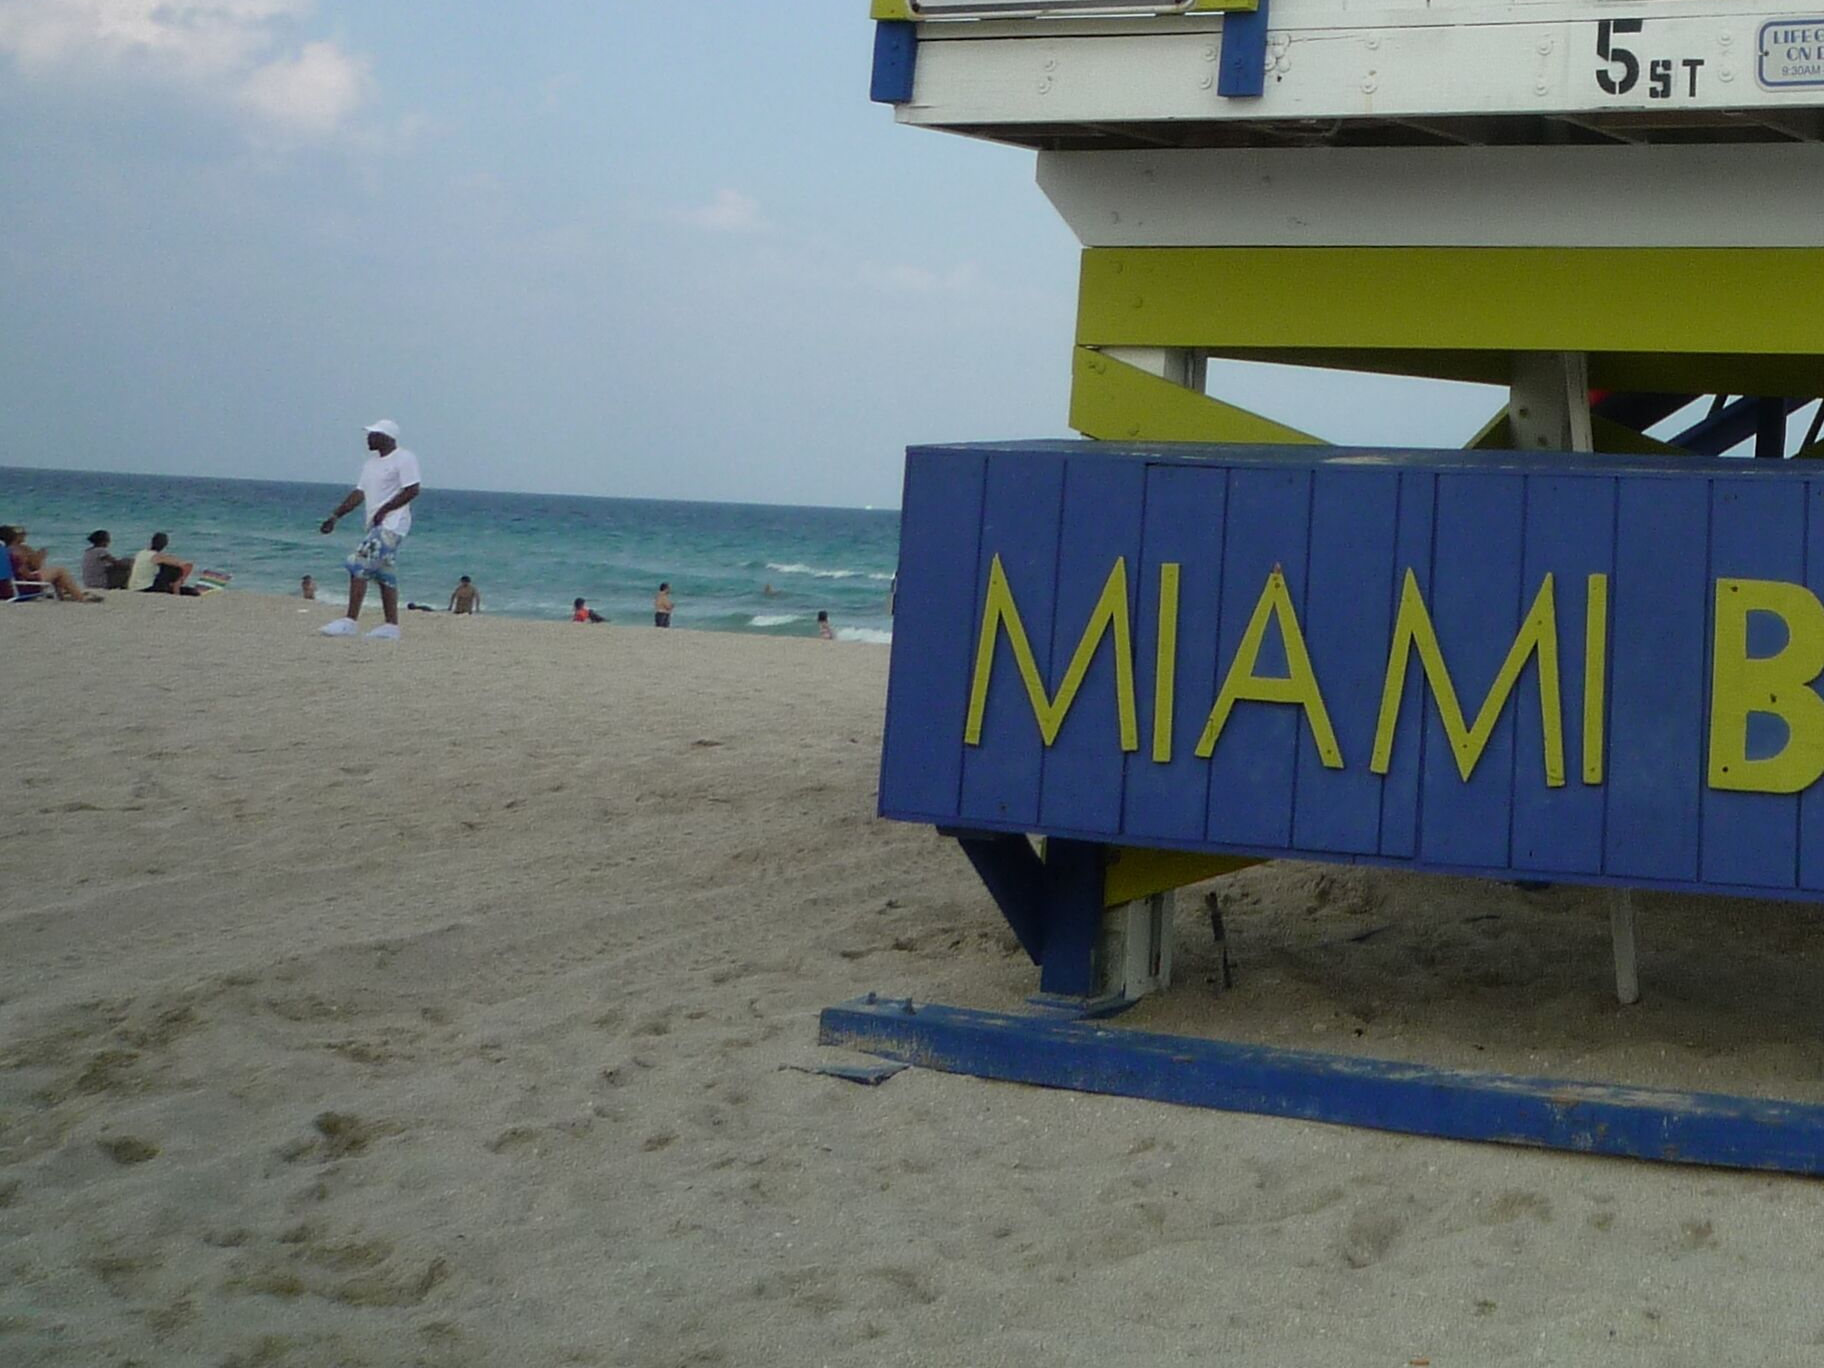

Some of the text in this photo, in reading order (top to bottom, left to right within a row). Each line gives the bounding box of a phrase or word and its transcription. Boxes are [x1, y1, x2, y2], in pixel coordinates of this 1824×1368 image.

[1596, 19, 1704, 99] 5 ST
[1786, 46, 1811, 62] ON
[966, 553, 1607, 788] MIAMI
